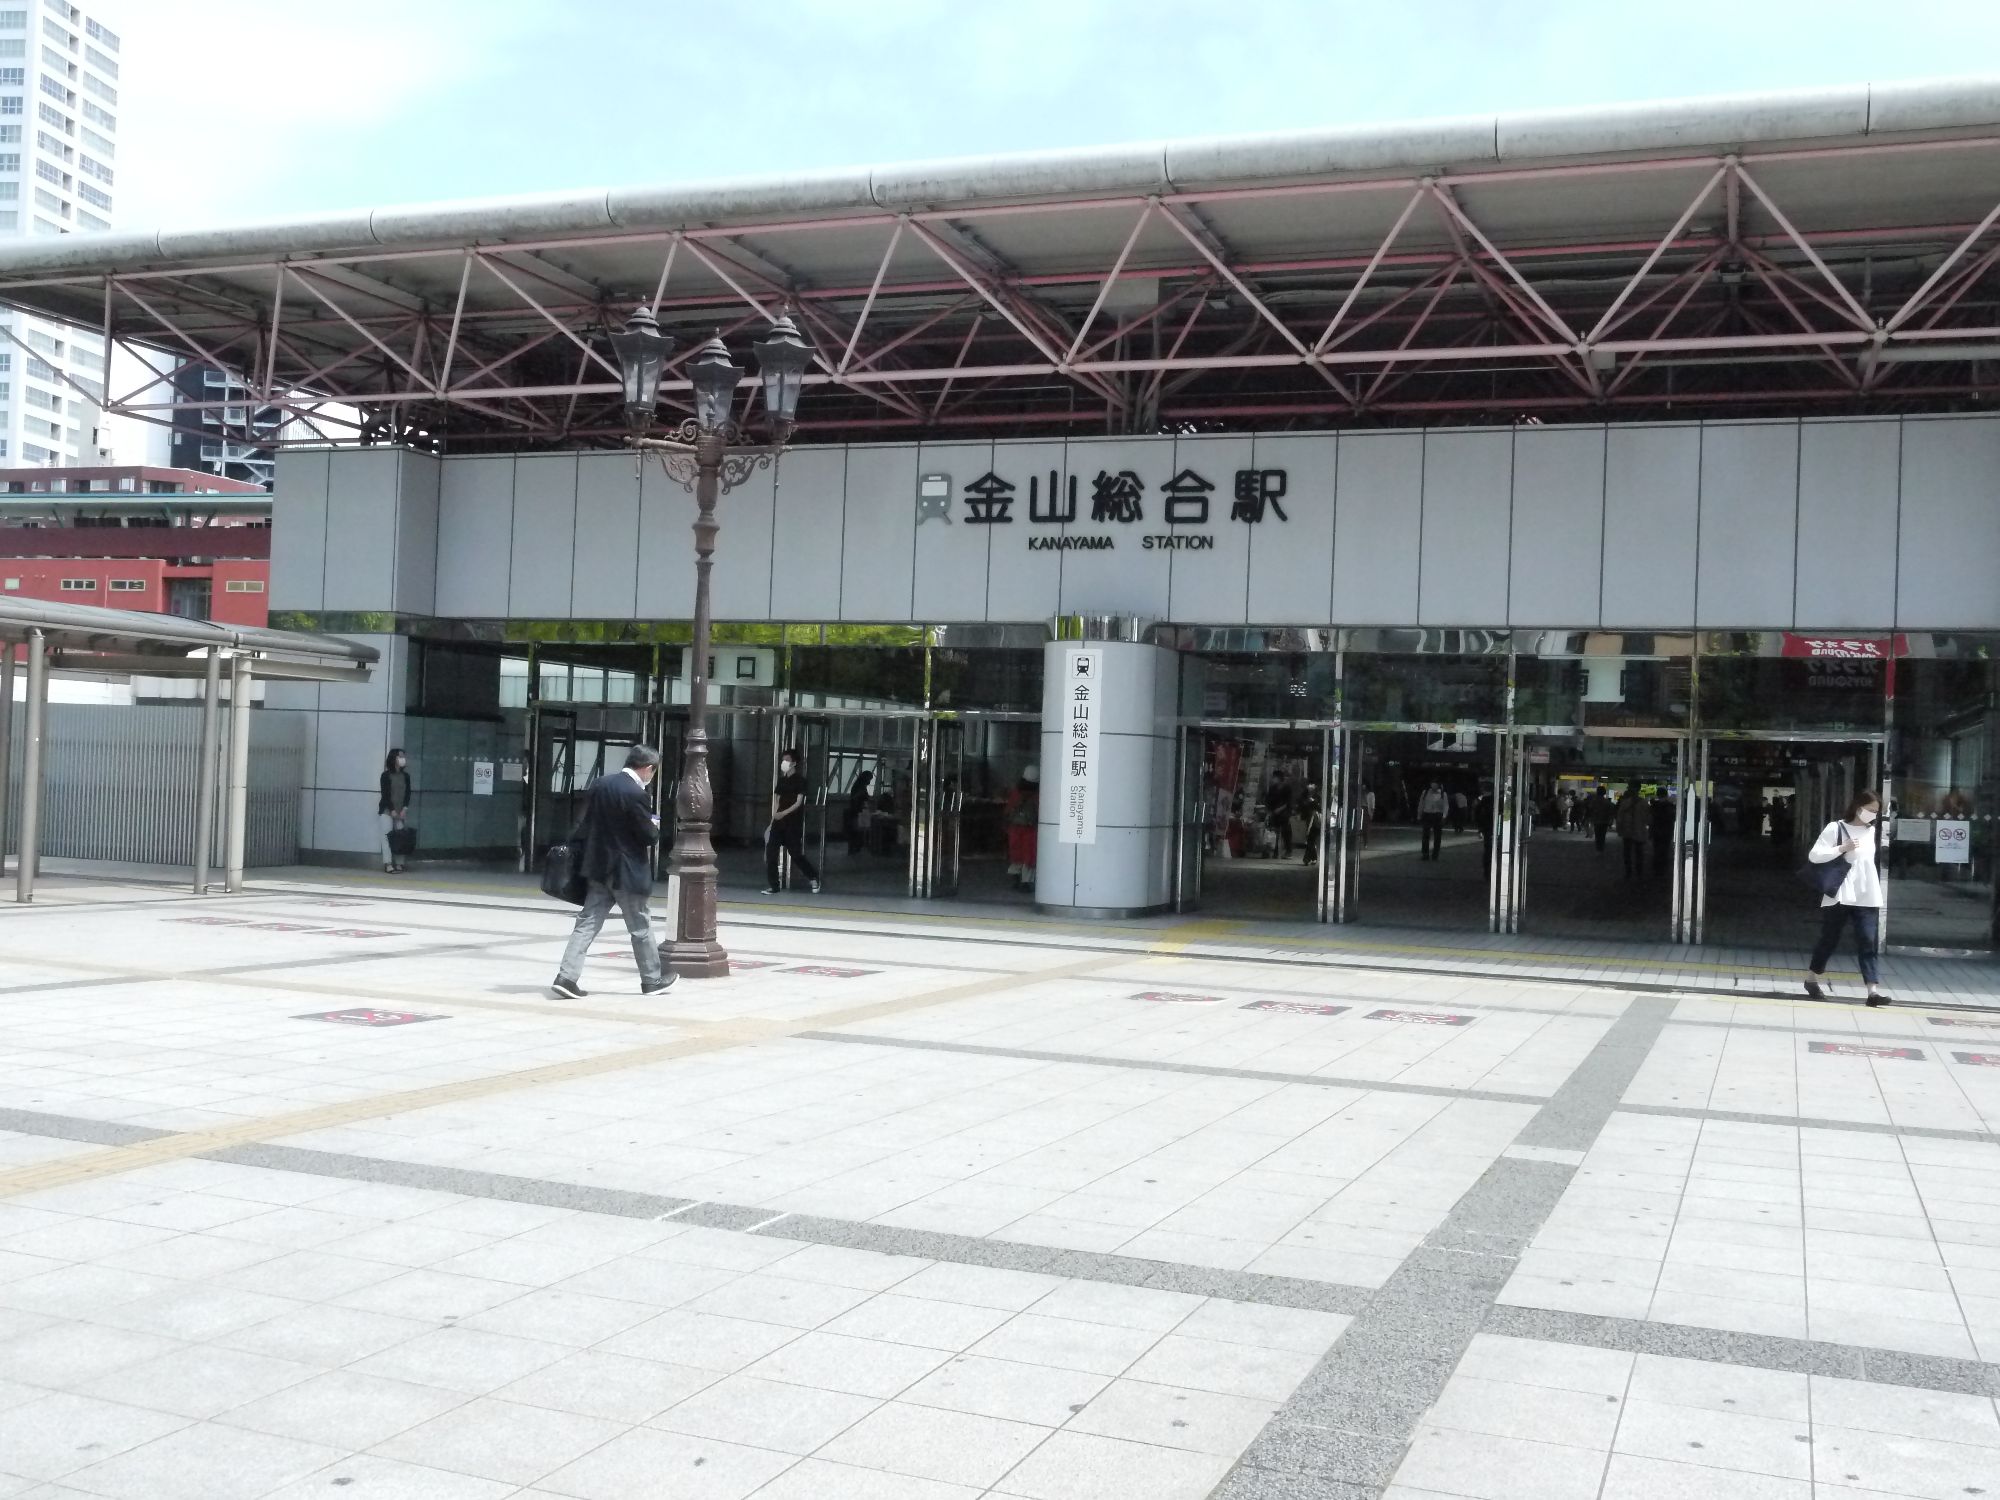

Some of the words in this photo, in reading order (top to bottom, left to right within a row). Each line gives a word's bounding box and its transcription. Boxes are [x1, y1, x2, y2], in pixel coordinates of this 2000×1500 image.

[963, 469, 1288, 524] 金山総合駅
[1028, 535, 1115, 551] KANAYAMA
[1141, 535, 1214, 550] STATION
[1070, 684, 1090, 777] 金山総合駅
[1069, 785, 1079, 818] Station
